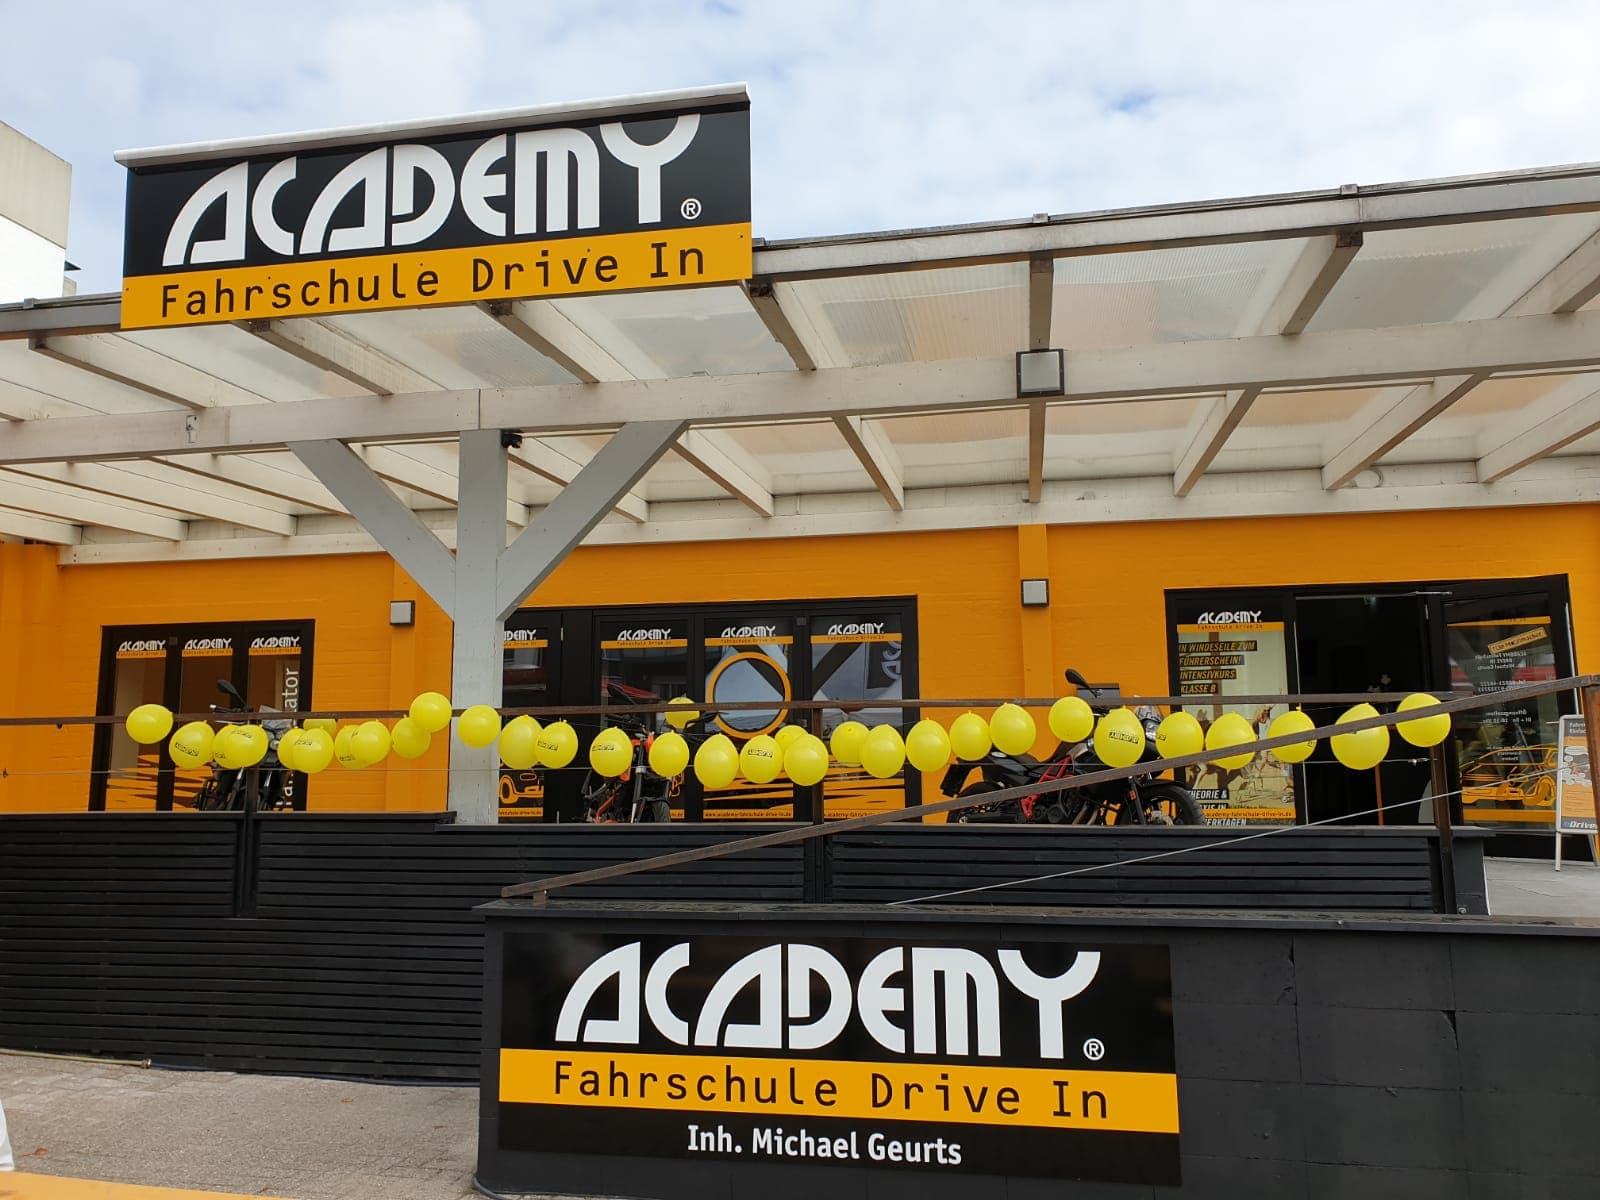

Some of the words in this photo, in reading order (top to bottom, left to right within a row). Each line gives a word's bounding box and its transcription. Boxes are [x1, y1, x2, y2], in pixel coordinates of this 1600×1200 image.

[163, 264, 438, 317] Fahrschule
[473, 249, 617, 292] Drive
[651, 242, 703, 278] In
[1181, 669, 1236, 680] INTENSIVKURS
[1181, 684, 1208, 694] KLASSE
[1210, 684, 1217, 693] B
[556, 1061, 836, 1107] Fahrschule
[872, 1073, 1019, 1115] Drive
[1054, 1081, 1106, 1119] In
[688, 1125, 742, 1154] Inh.
[753, 1128, 859, 1160] Michael
[868, 1133, 961, 1165] Geurts
